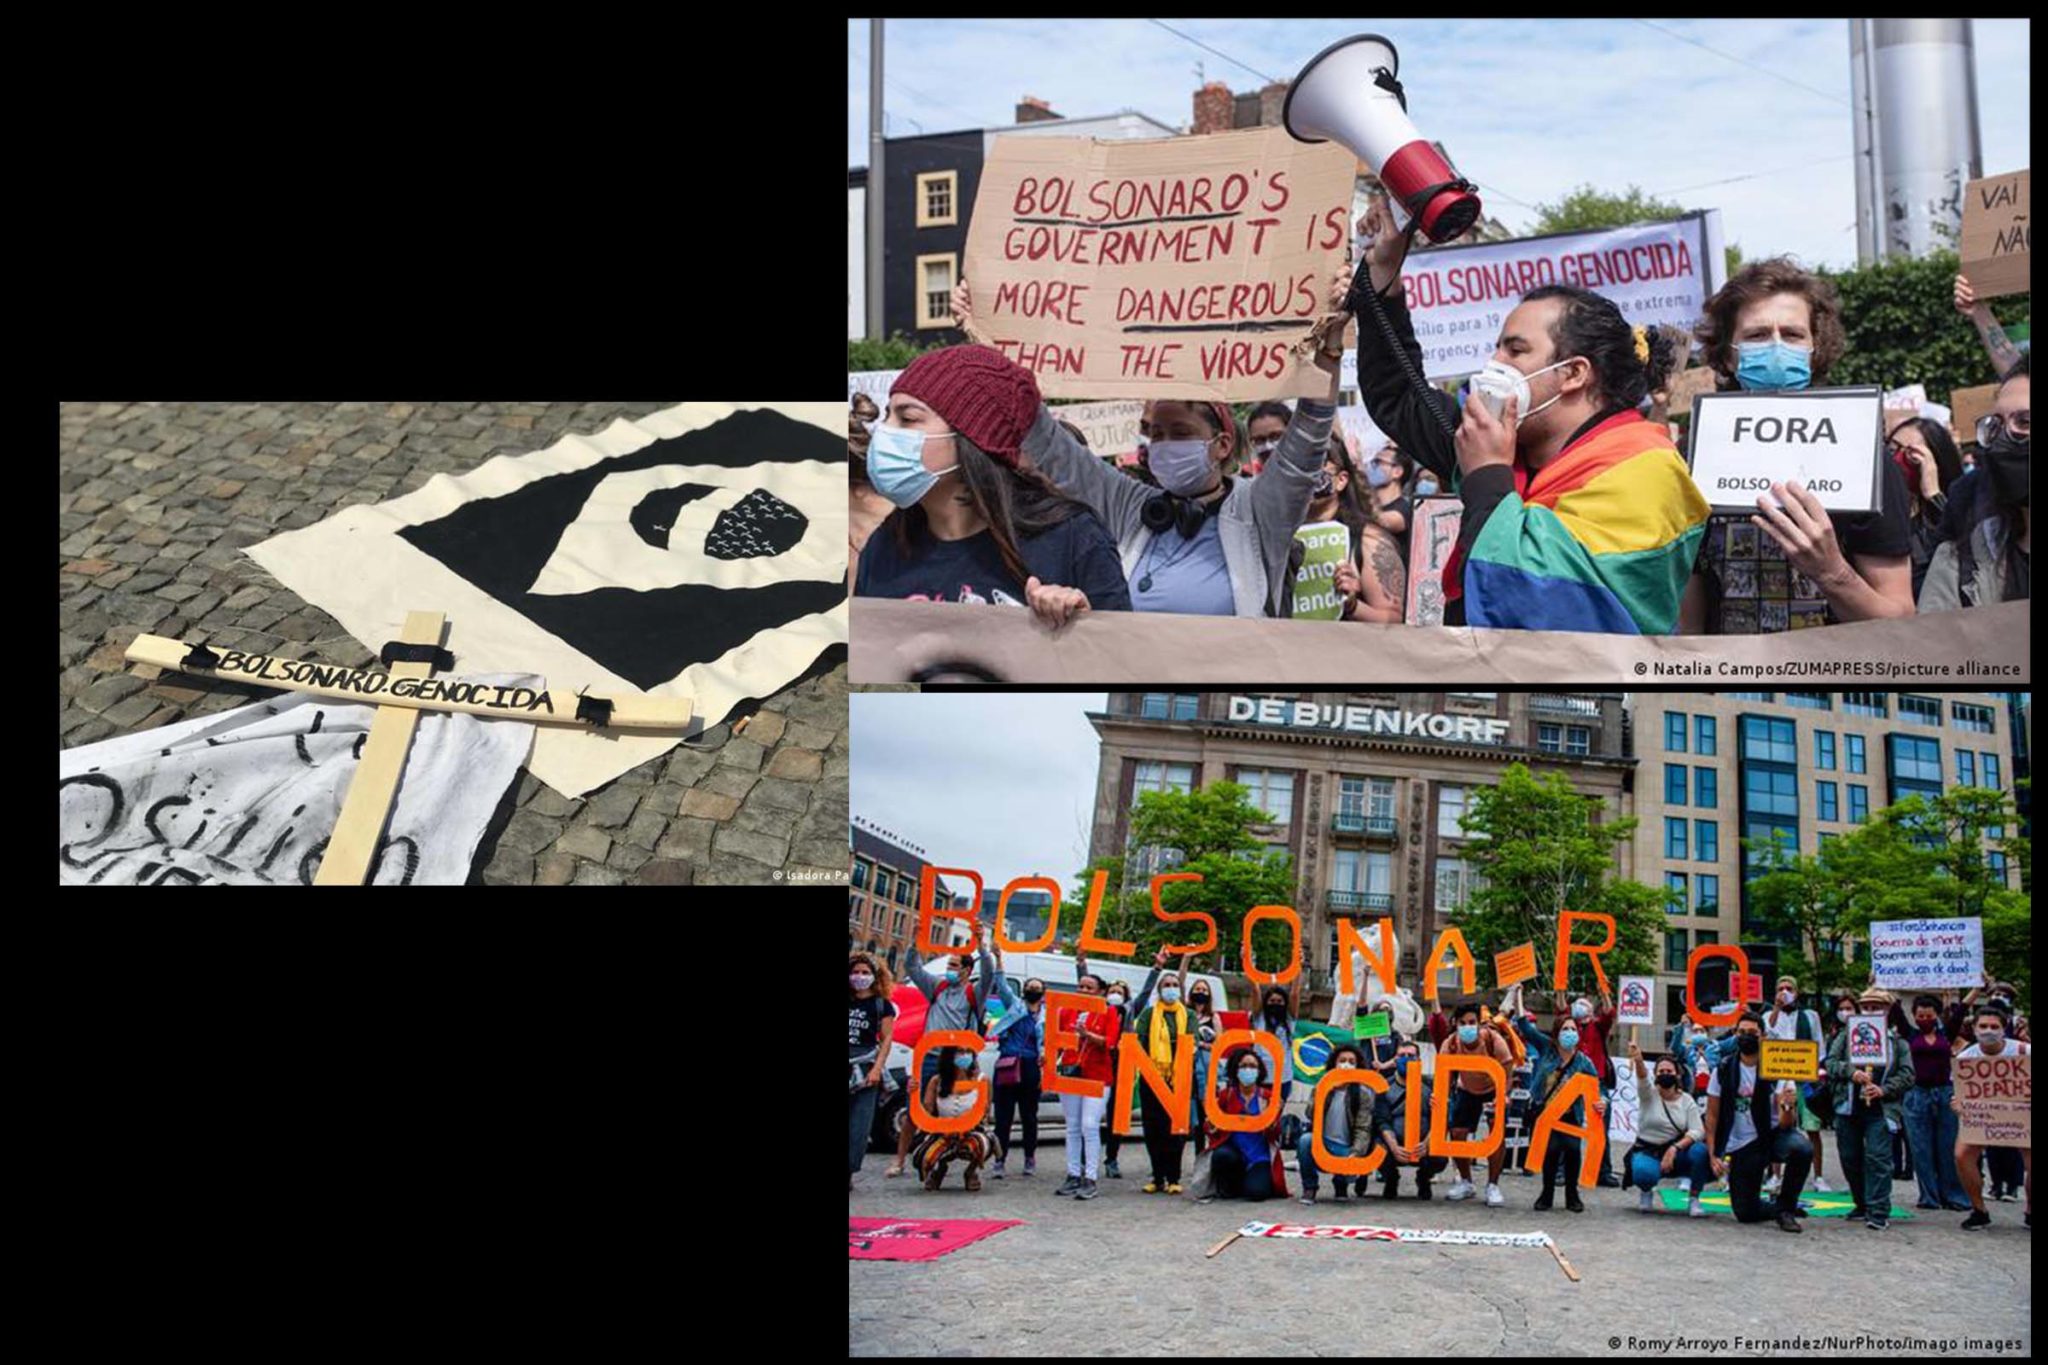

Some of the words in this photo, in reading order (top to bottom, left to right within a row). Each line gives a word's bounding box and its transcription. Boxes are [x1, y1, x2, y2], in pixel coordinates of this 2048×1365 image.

[1013, 171, 1290, 222] BOLSONARO'S
[1981, 177, 2018, 210] VAI
[1004, 219, 1280, 265] GOVERNMENT
[1306, 206, 1347, 251] IS
[1992, 215, 2030, 256] NÃ
[1402, 256, 1554, 310] BOLSONARO
[1562, 239, 1694, 292] GENOCIDA
[994, 280, 1089, 326] MORE
[1117, 273, 1317, 322] DANGEROUS
[993, 340, 1084, 375] THAN
[1120, 343, 1183, 380] THE
[1201, 338, 1288, 381] VIRUS
[1732, 416, 1838, 444] FORA
[1228, 695, 1285, 723] DE
[908, 988, 1608, 1190] GENOCIDA
[1957, 1059, 2029, 1080] 500K
[1964, 1079, 2031, 1099] DEATHS
